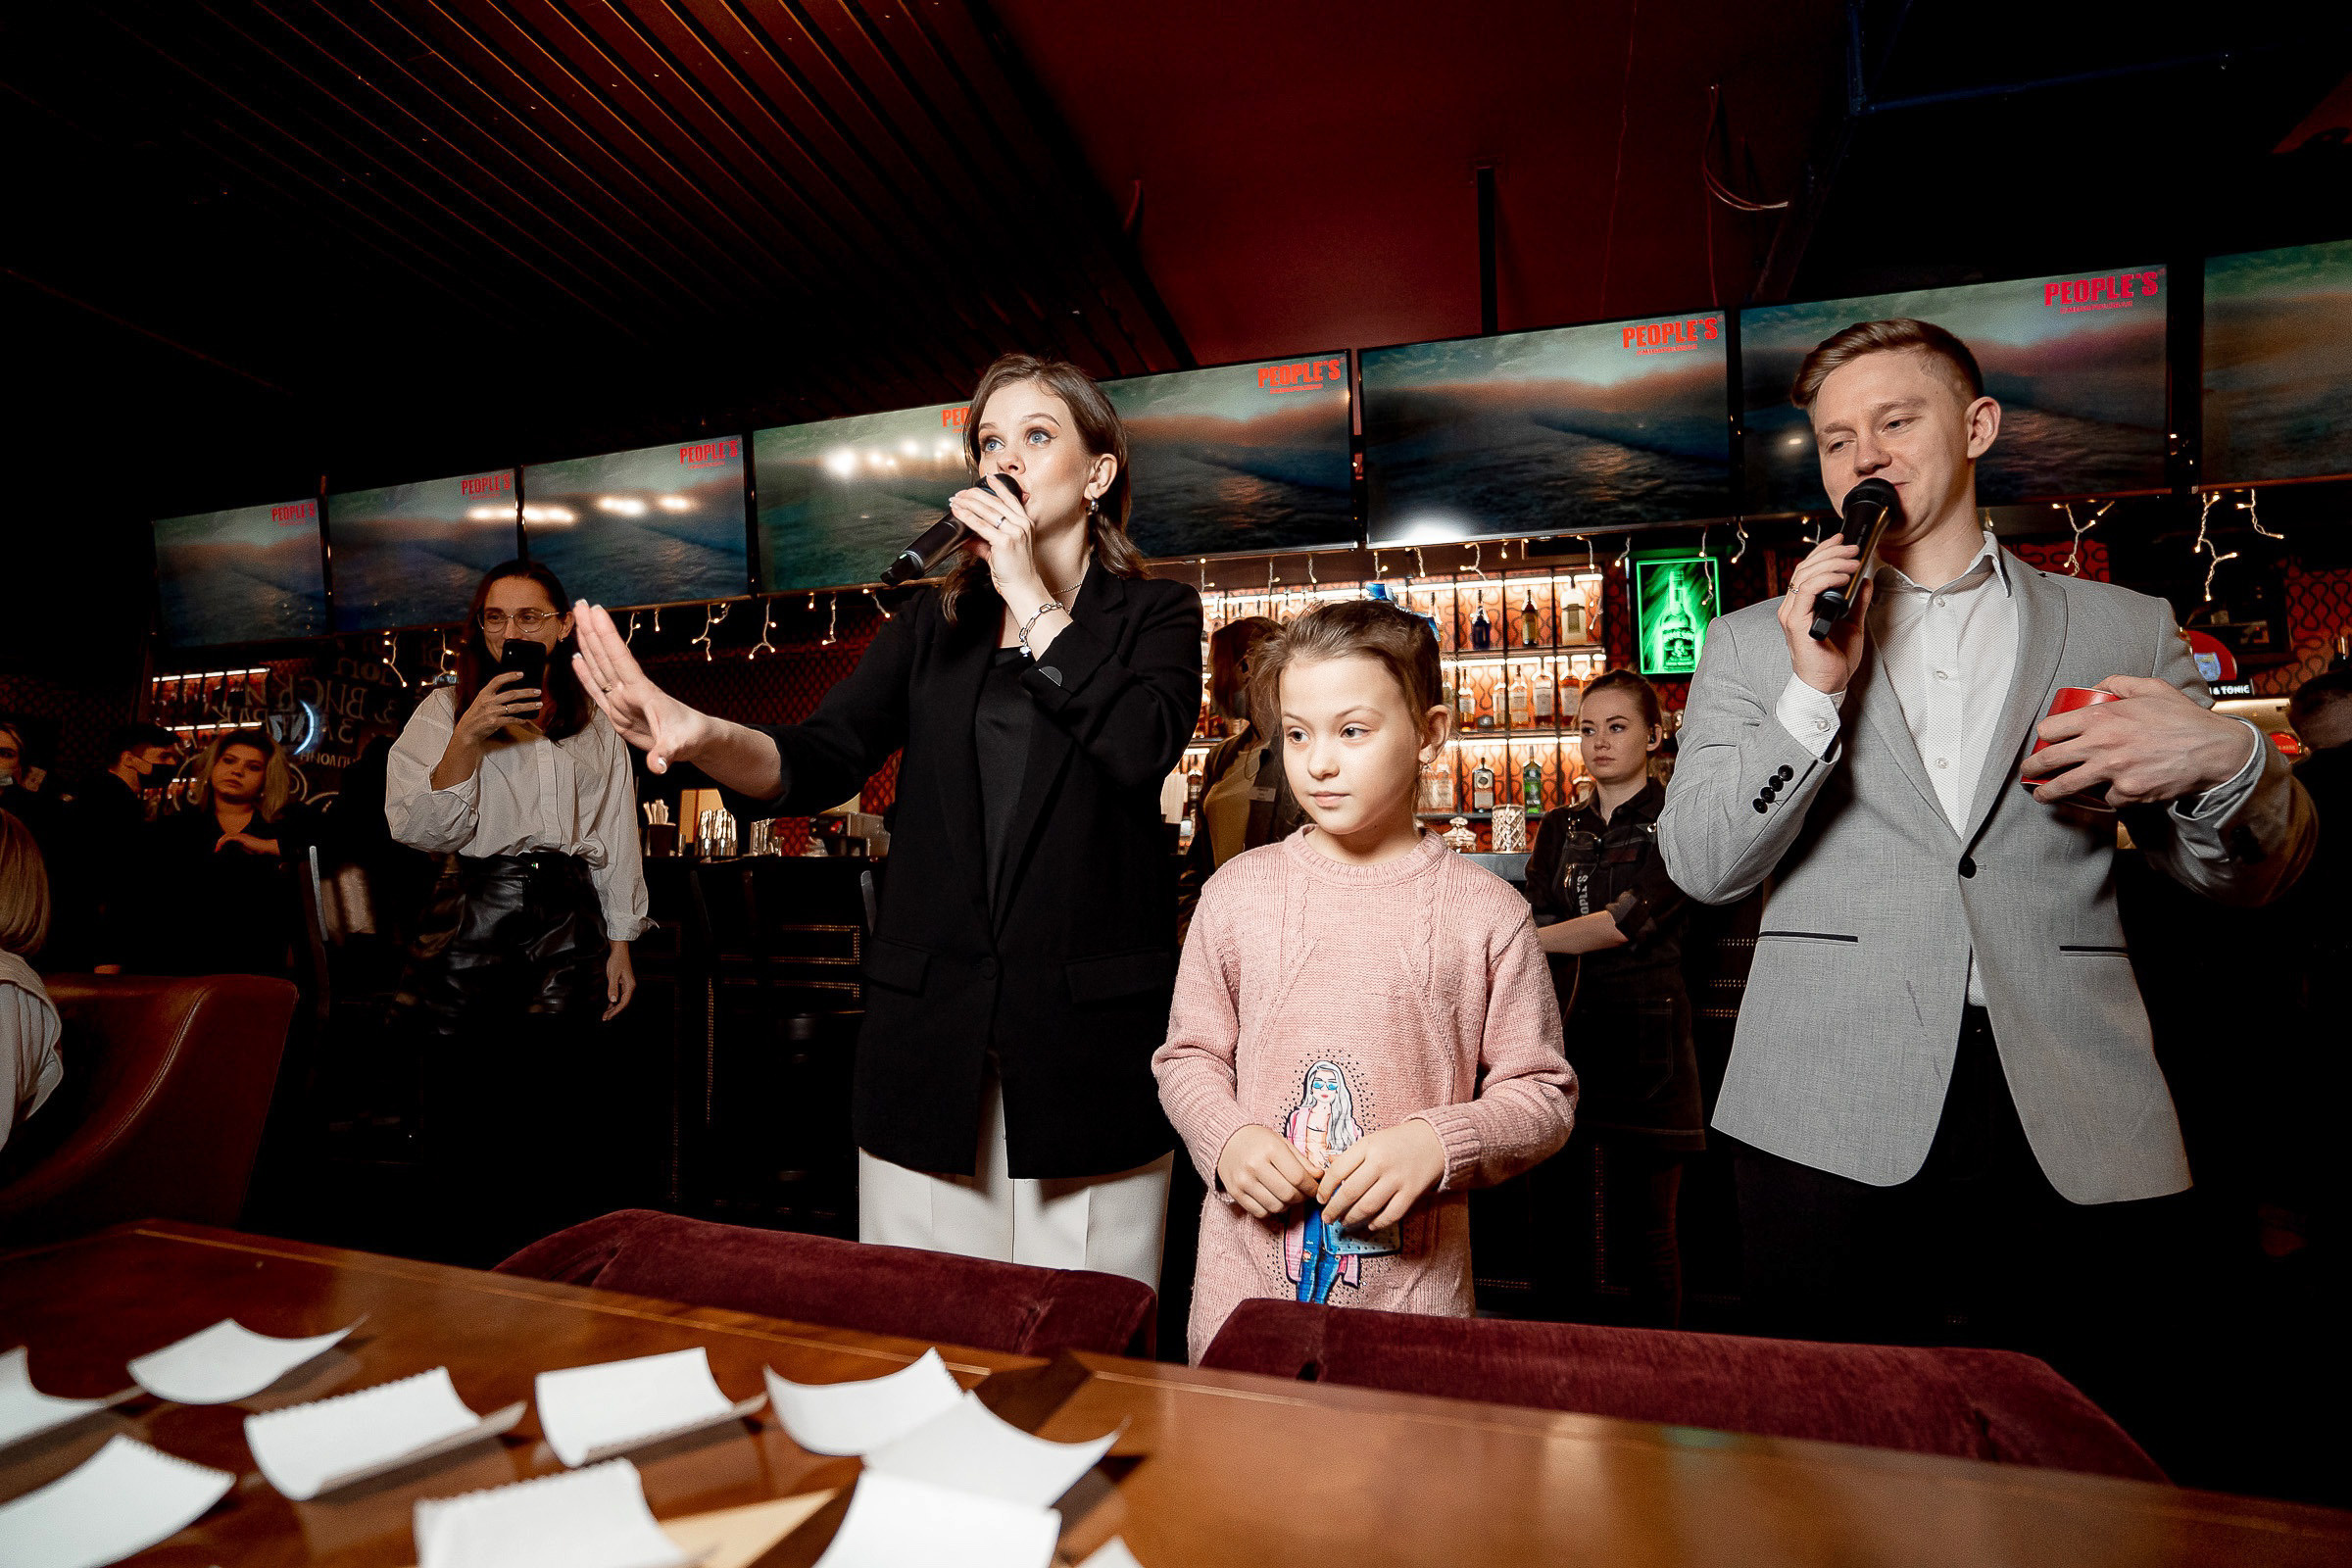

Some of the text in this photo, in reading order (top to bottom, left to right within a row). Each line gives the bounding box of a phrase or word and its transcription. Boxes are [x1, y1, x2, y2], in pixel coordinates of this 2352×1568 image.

[2043, 271, 2159, 307] PEOPLE'S
[1622, 317, 1719, 350] PEOPLE'S
[1257, 359, 1342, 389] PEOPLE'S
[2221, 684, 2251, 695] TONIC
[1576, 874, 1589, 916] OPLE'S
